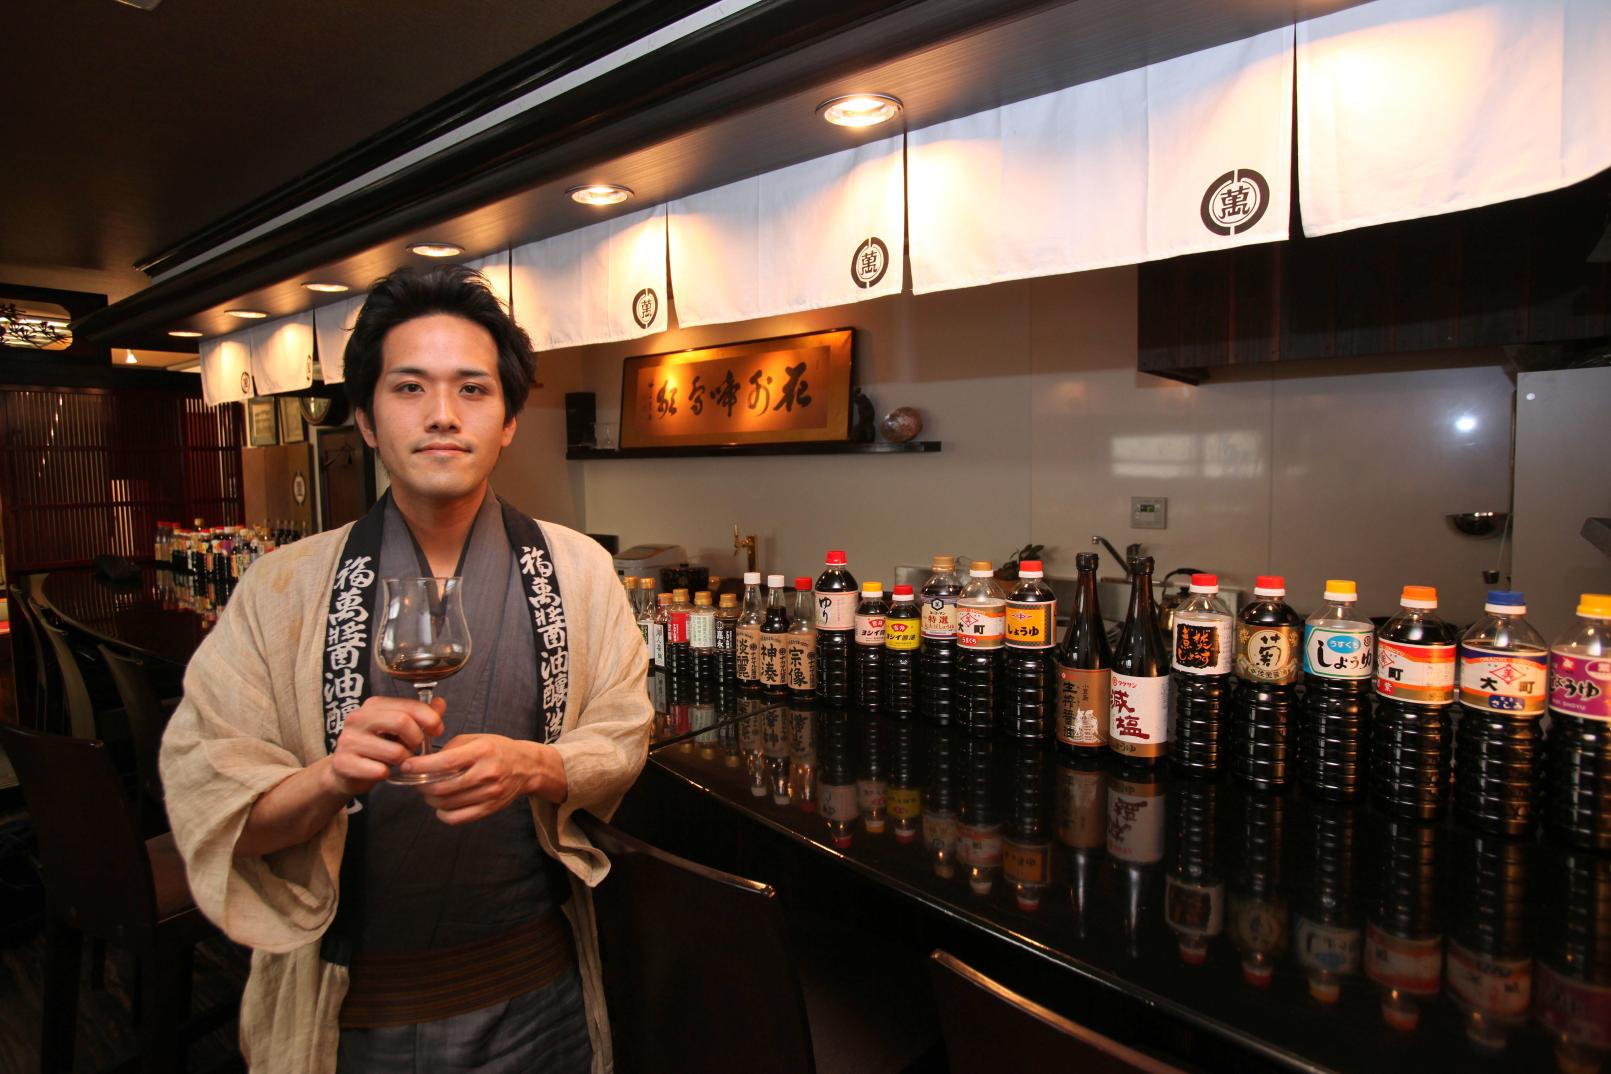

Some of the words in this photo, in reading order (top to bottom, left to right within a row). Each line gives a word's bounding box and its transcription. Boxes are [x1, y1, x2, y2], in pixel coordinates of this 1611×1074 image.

[1218, 185, 1251, 220] 萬
[861, 250, 878, 276] 萬
[1007, 624, 1040, 637] しょうゆ
[789, 646, 808, 687] 宗像
[1317, 640, 1373, 670] しょうゆ
